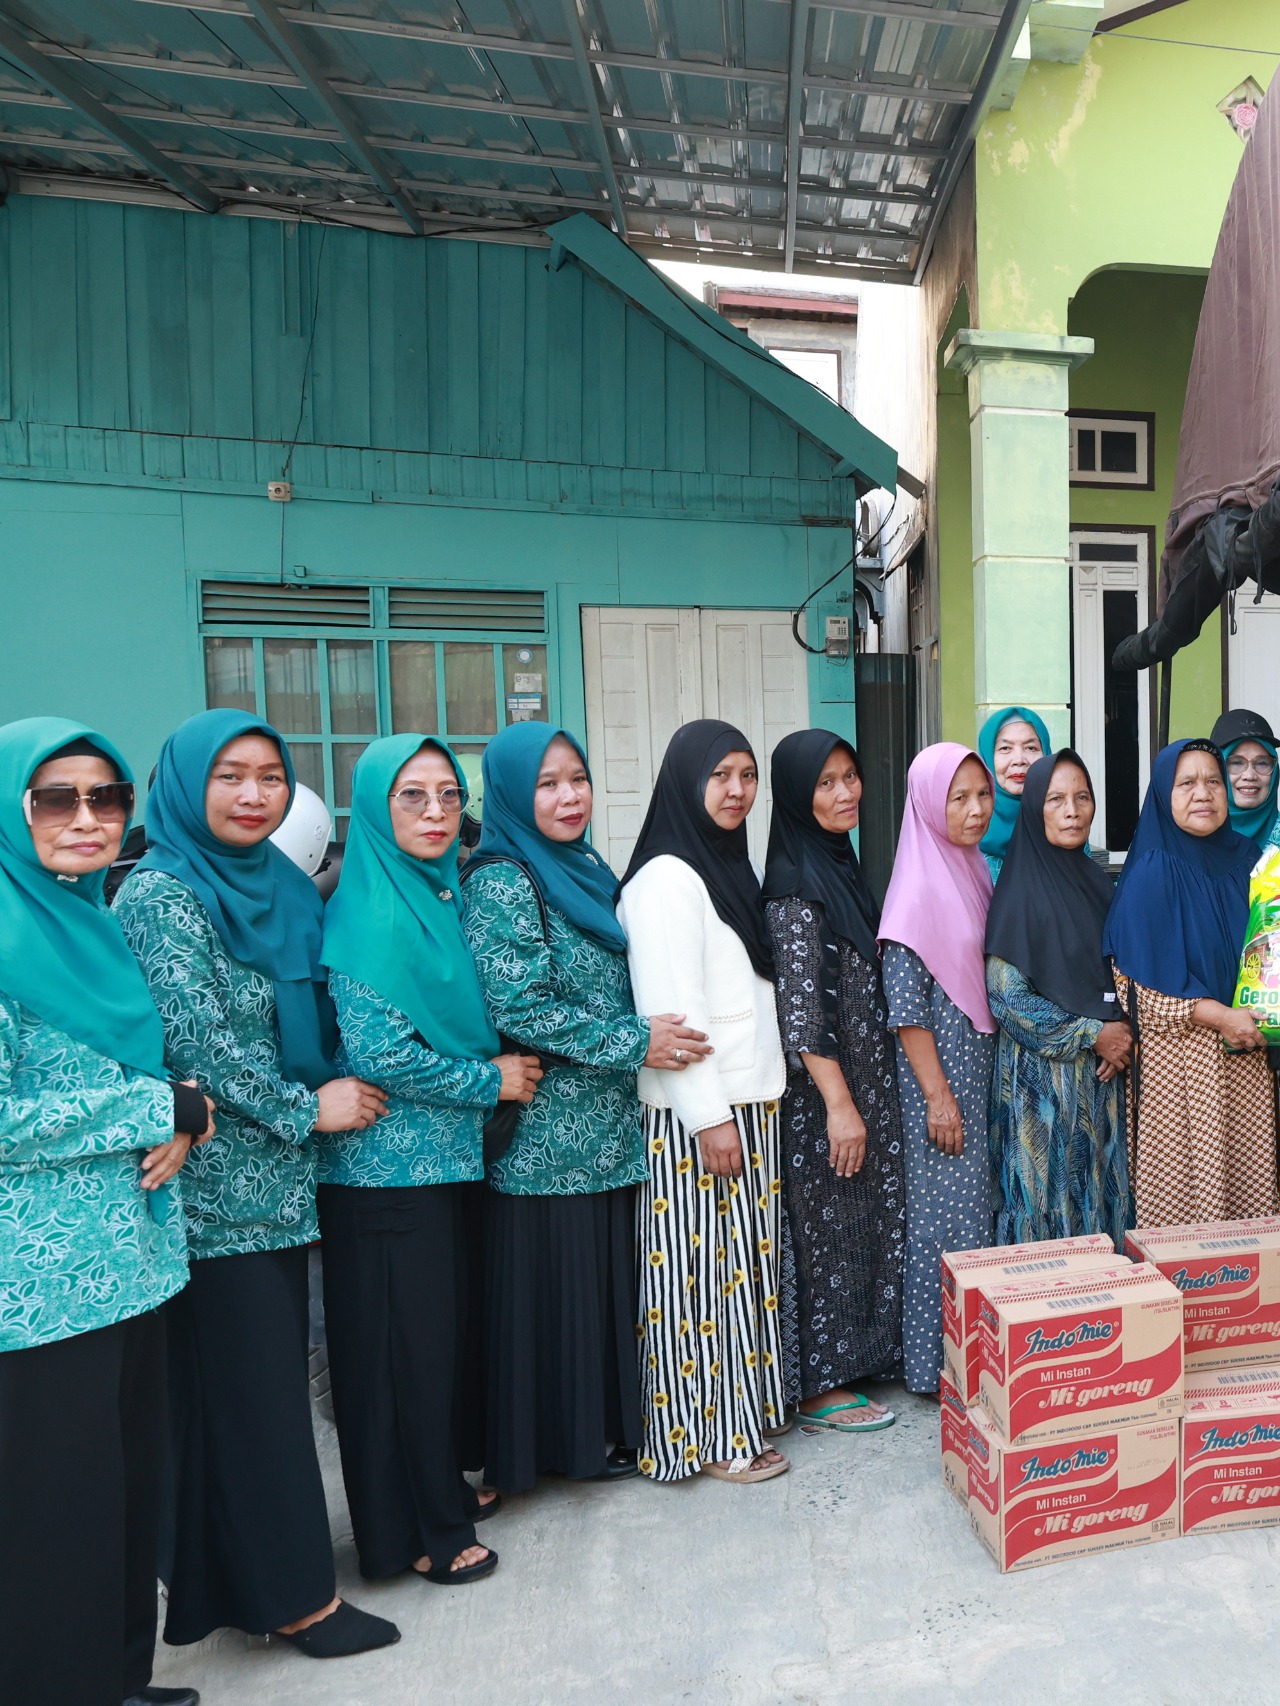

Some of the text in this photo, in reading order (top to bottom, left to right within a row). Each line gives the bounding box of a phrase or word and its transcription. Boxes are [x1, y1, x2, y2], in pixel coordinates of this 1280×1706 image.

[1172, 1264, 1252, 1291] Indomie
[1184, 1306, 1230, 1319] Mi Instan
[1014, 1320, 1113, 1364] Indomie
[1184, 1323, 1216, 1342] Mi
[1040, 1366, 1091, 1382] Mi Instan
[1039, 1378, 1154, 1408] Mi goreng
[1010, 1448, 1109, 1494] Indomie
[1213, 1465, 1262, 1479] Mi Instan
[1036, 1493, 1087, 1511] Mi Instan
[1211, 1483, 1248, 1504] Mi
[1034, 1503, 1150, 1536] Mi goreng
